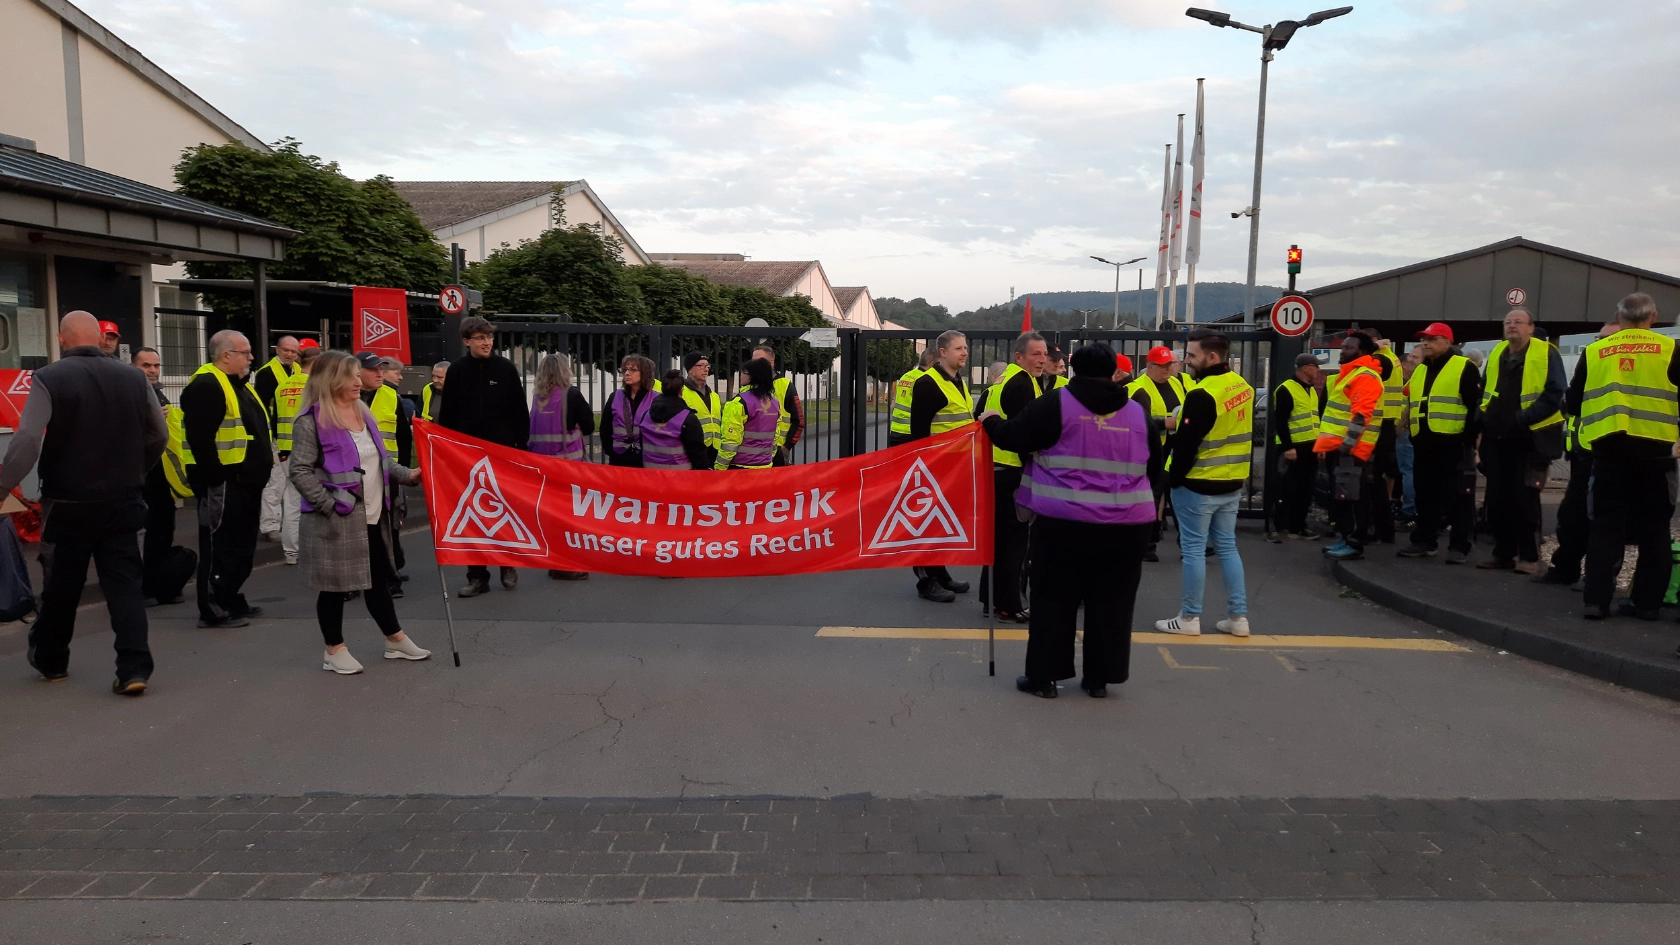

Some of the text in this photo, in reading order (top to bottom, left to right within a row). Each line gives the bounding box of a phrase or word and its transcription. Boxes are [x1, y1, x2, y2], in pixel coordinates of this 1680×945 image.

[1282, 306, 1302, 325] 10
[570, 484, 837, 527] Warnstreik
[564, 528, 835, 564] unser gutes Recht
